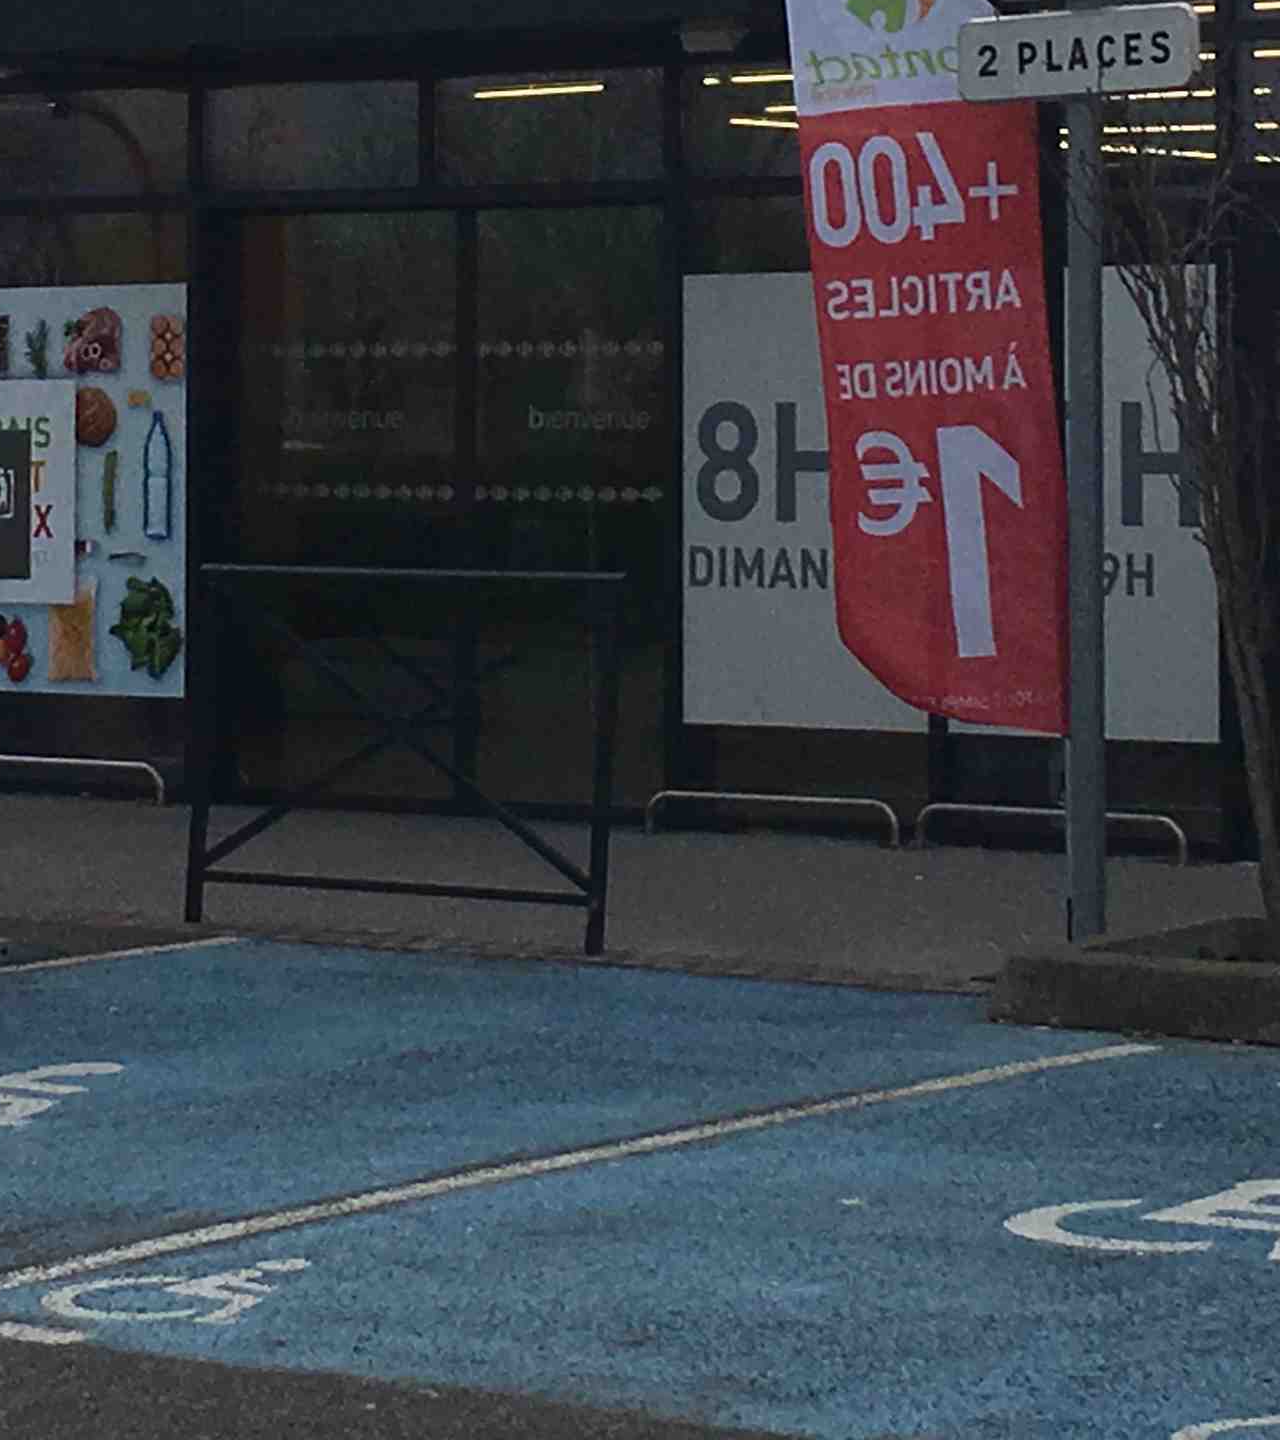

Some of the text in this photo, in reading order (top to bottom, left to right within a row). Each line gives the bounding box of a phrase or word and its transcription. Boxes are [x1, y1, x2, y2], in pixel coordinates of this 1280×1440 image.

[978, 31, 1172, 78] 2 PLACES
[689, 544, 828, 589] DIMAN
